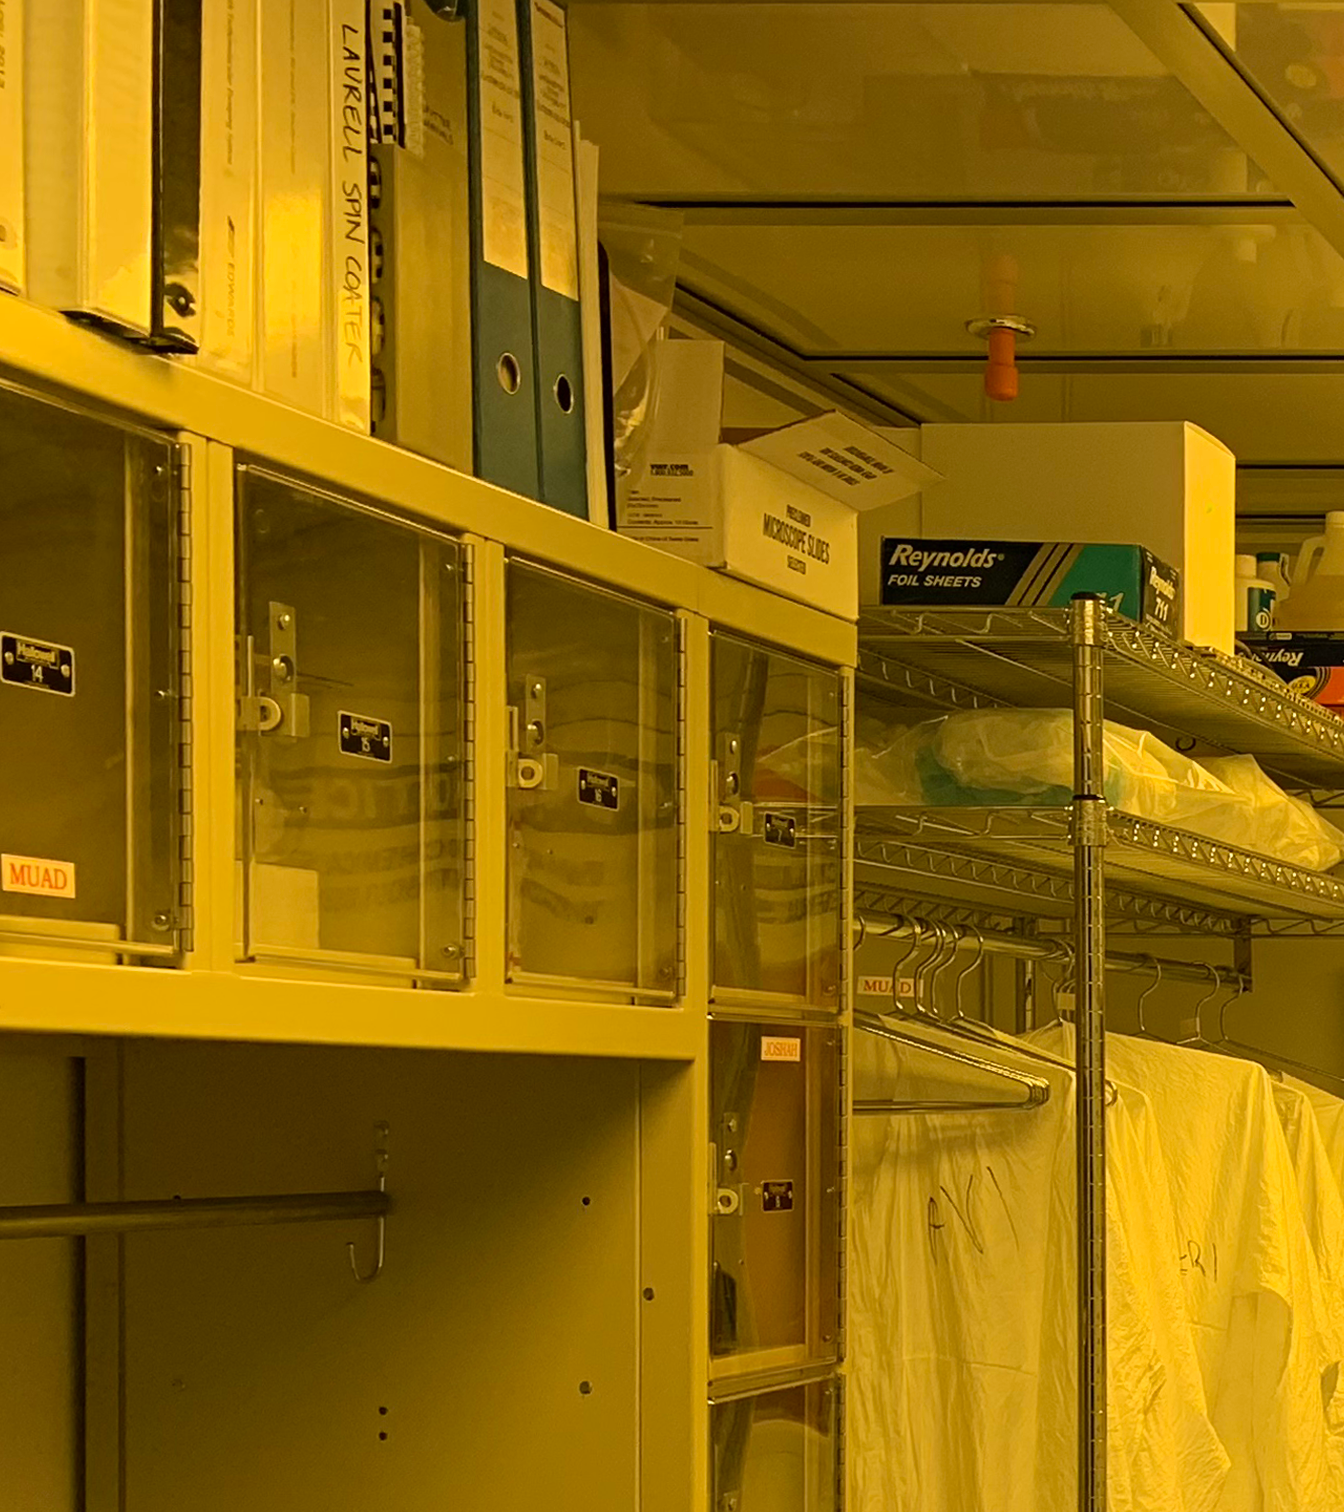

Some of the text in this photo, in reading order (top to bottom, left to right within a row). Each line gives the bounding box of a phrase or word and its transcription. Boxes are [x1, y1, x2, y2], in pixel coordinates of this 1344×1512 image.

[342, 24, 365, 365] LAURELL SPIN COATER
[763, 512, 830, 565] MICROSCOPE SLIDES
[889, 543, 997, 571] Reynolds
[887, 574, 982, 588] FOIL SHEETS
[1150, 566, 1176, 600] Reynolds
[1154, 597, 1169, 621] 711
[30, 664, 44, 683] 14
[9, 862, 68, 891] MUAD
